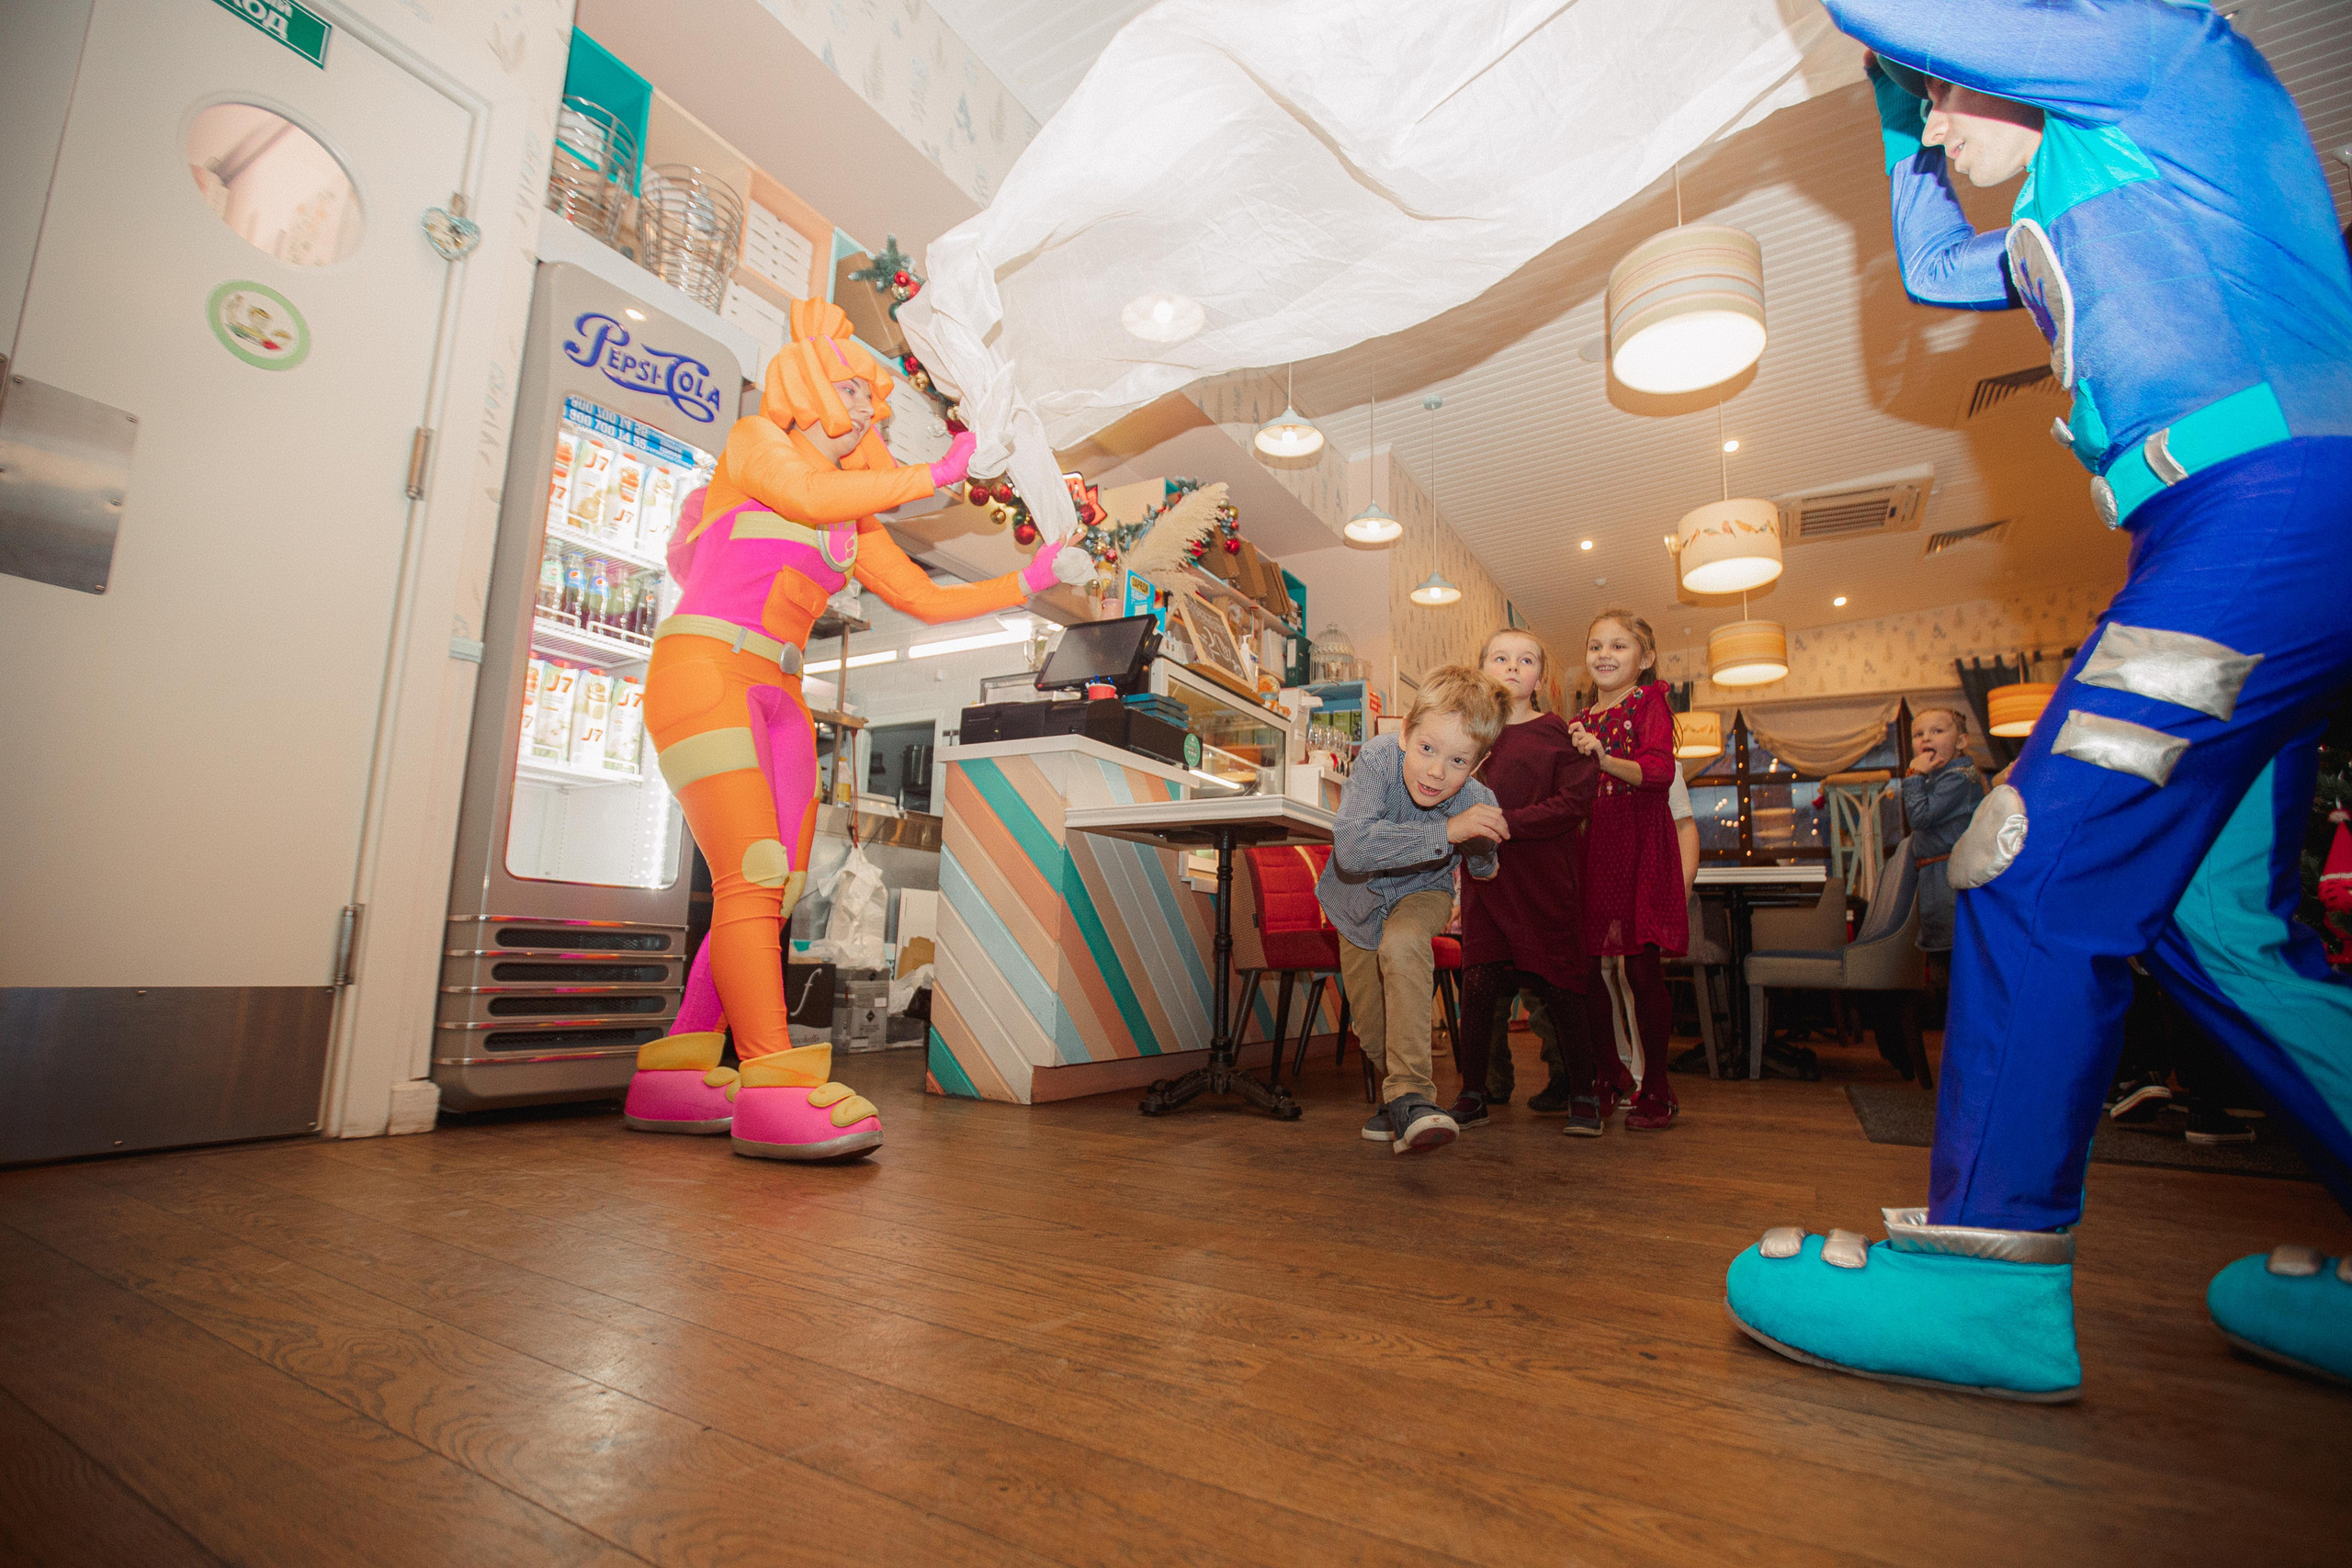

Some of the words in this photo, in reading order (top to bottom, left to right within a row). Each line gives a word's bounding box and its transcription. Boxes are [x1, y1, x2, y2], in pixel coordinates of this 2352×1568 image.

[232, 0, 289, 39] ОД
[594, 419, 615, 436] 700
[617, 428, 631, 443] 14
[632, 435, 647, 450] 55
[584, 453, 609, 471] J7
[614, 509, 635, 524] J7
[546, 674, 573, 693] J7
[617, 693, 644, 707] J7
[581, 728, 604, 742] J7
